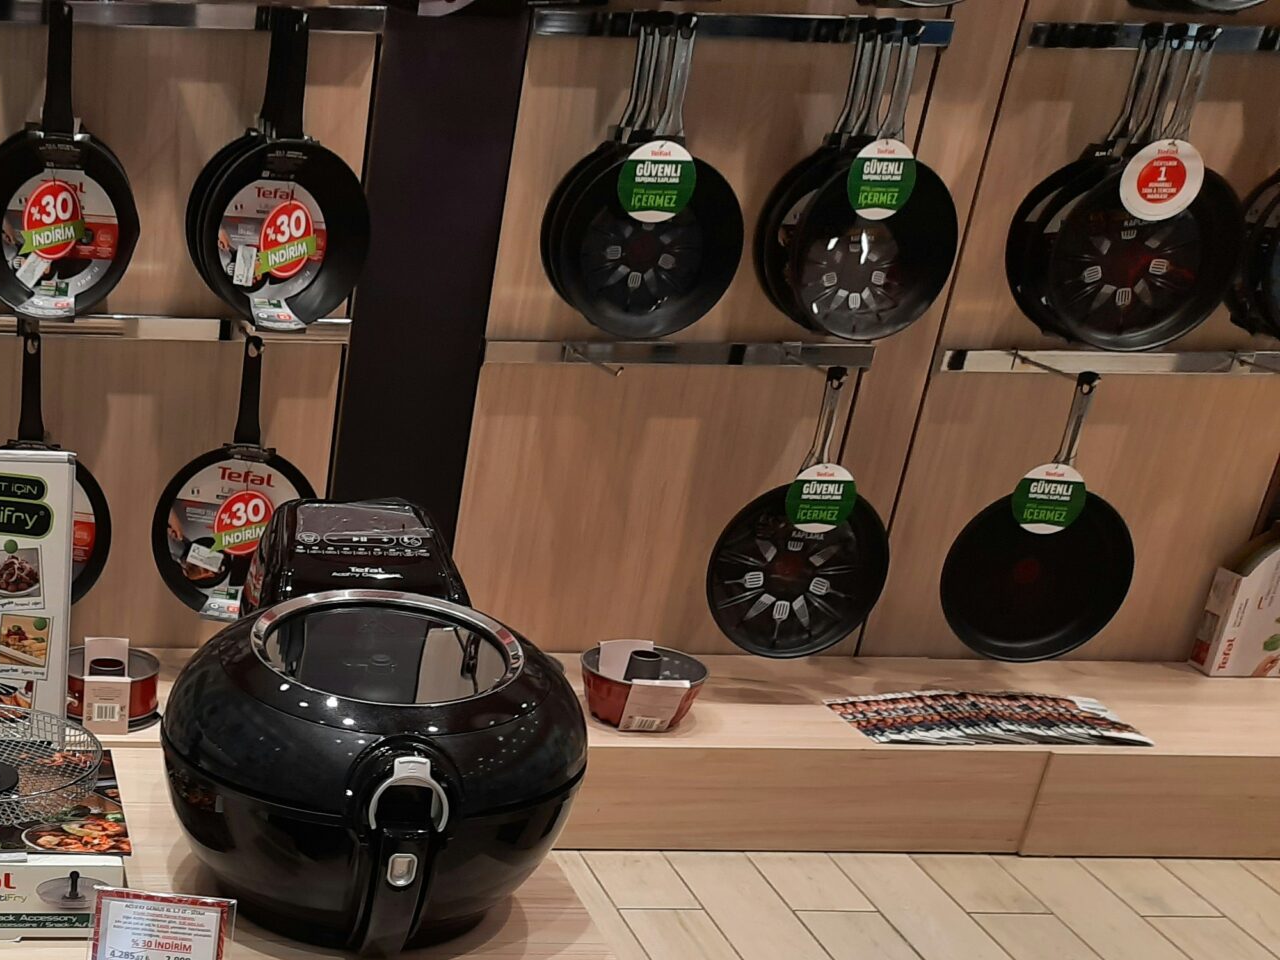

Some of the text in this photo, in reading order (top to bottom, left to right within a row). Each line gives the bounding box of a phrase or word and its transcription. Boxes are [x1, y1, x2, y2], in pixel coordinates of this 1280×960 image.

[1157, 167, 1167, 181] 1
[255, 186, 296, 201] Tefal
[631, 194, 677, 208] İÇERMEZ
[858, 191, 898, 206] İÇERMEZ
[31, 191, 73, 224] %30
[266, 209, 306, 243] %30
[32, 225, 75, 246] İNDİRİM
[268, 243, 307, 266] İNDİRİM
[218, 466, 275, 488] Tefal
[11, 482, 37, 495] İÇİN
[221, 498, 265, 526] %30
[797, 508, 838, 520] İÇERMEZ
[1023, 508, 1067, 521] İÇERMEZ
[20, 914, 79, 924] Accessory
[142, 940, 153, 948] 30
[154, 940, 192, 952] İNDİRİM
